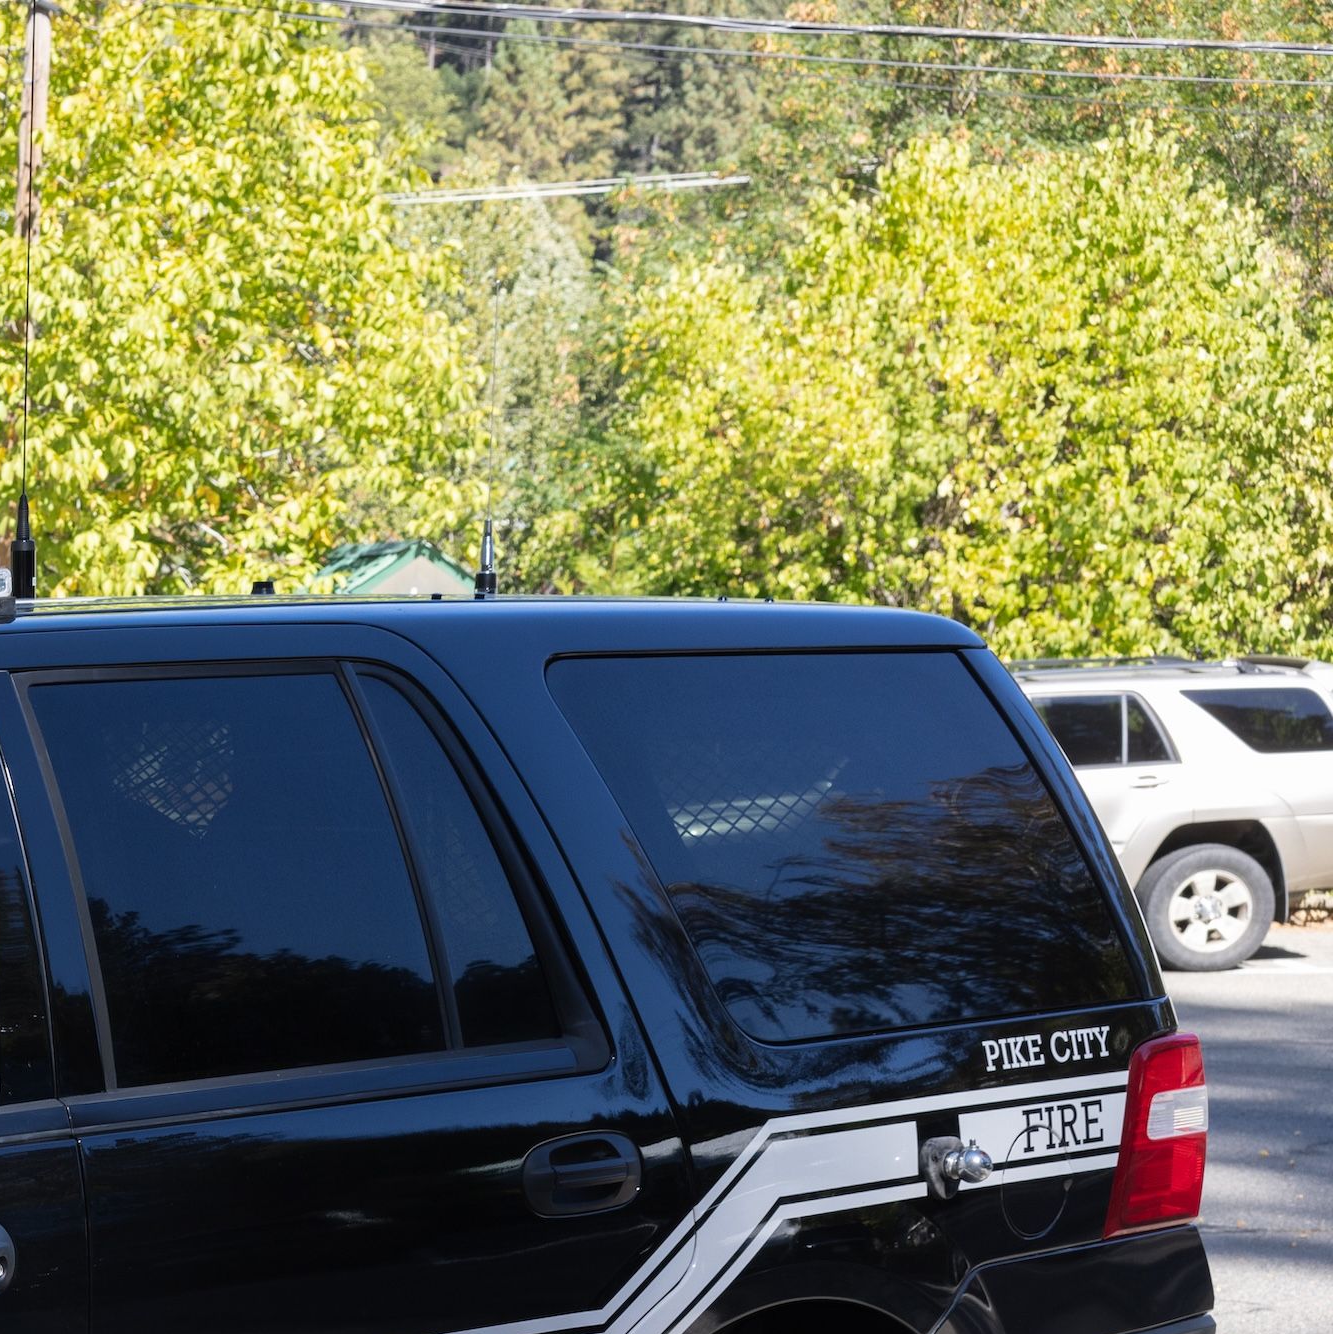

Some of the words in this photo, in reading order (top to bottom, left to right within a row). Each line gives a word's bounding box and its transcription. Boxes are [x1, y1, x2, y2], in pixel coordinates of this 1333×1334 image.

[982, 1033, 1045, 1072] PIKE
[1049, 1026, 1110, 1063] CITY
[1022, 1100, 1103, 1153] FIRE
